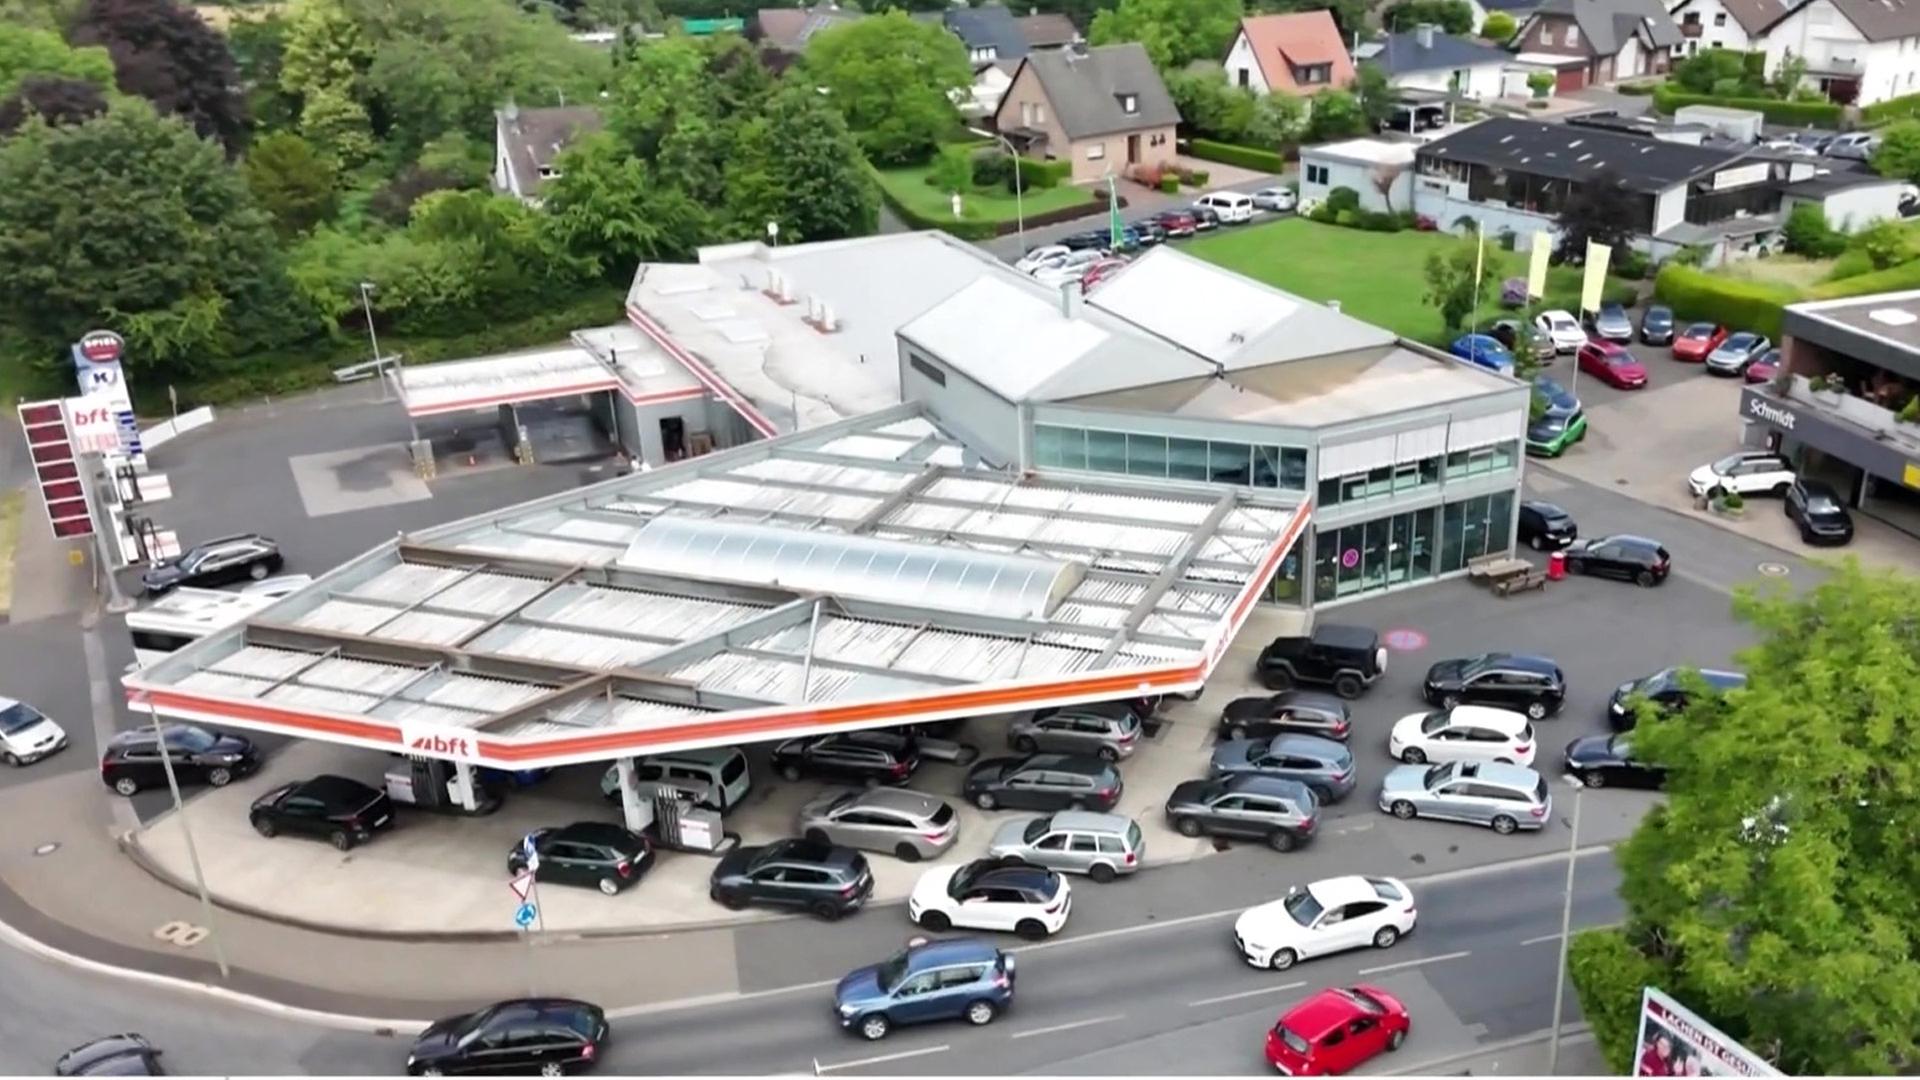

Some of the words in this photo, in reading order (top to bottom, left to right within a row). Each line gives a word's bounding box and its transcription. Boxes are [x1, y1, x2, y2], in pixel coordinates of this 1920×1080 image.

[75, 408, 108, 426] bft
[1750, 398, 1796, 430] Schmidt
[434, 735, 468, 757] bft
